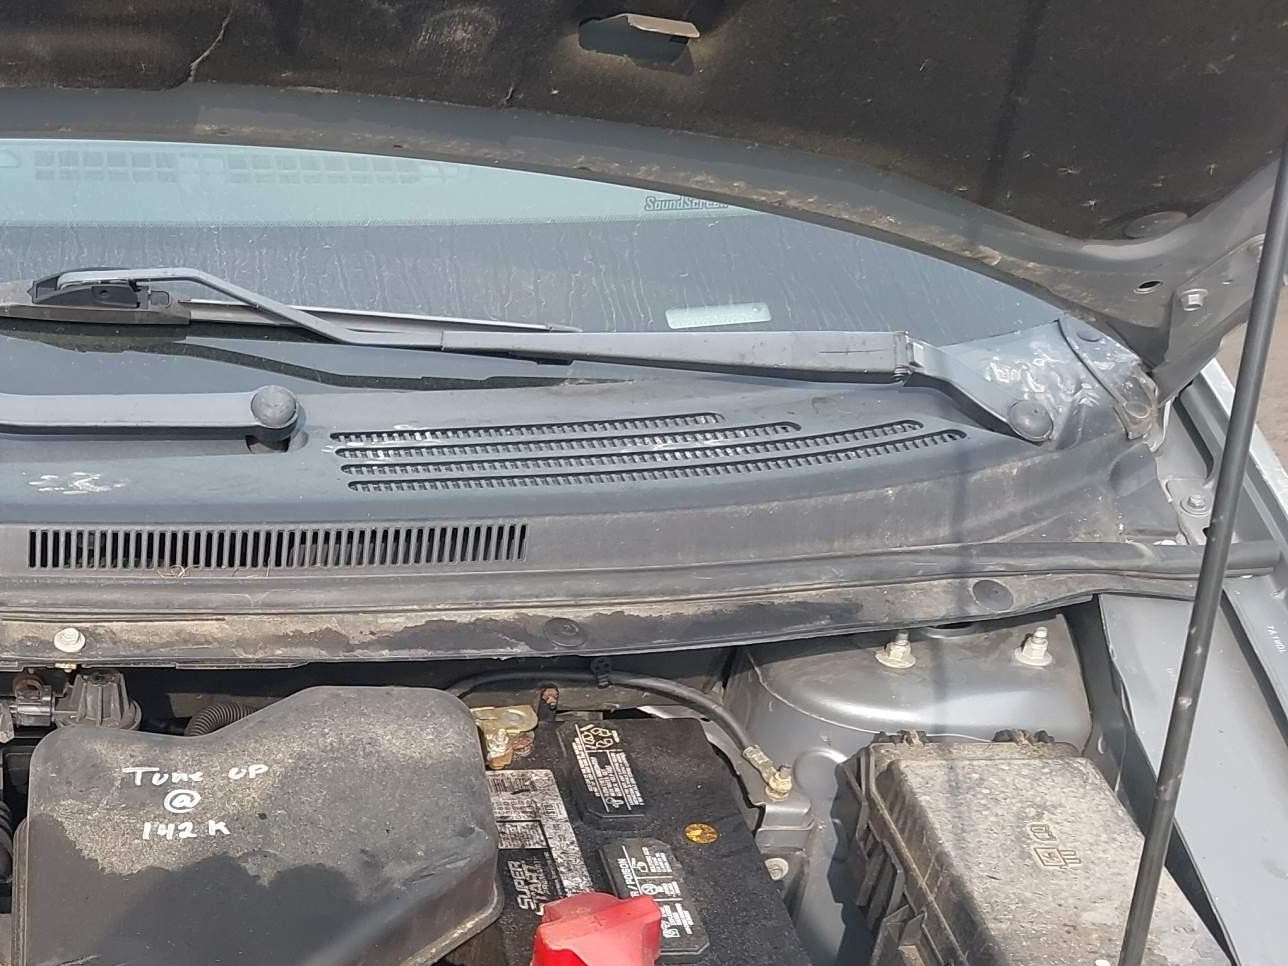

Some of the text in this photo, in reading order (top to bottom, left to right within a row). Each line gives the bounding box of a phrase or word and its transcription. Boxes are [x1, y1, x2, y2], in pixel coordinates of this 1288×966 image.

[163, 789, 202, 814] @
[142, 821, 198, 840] 142
[617, 858, 635, 885] POISON
[507, 860, 535, 910] SUPER
